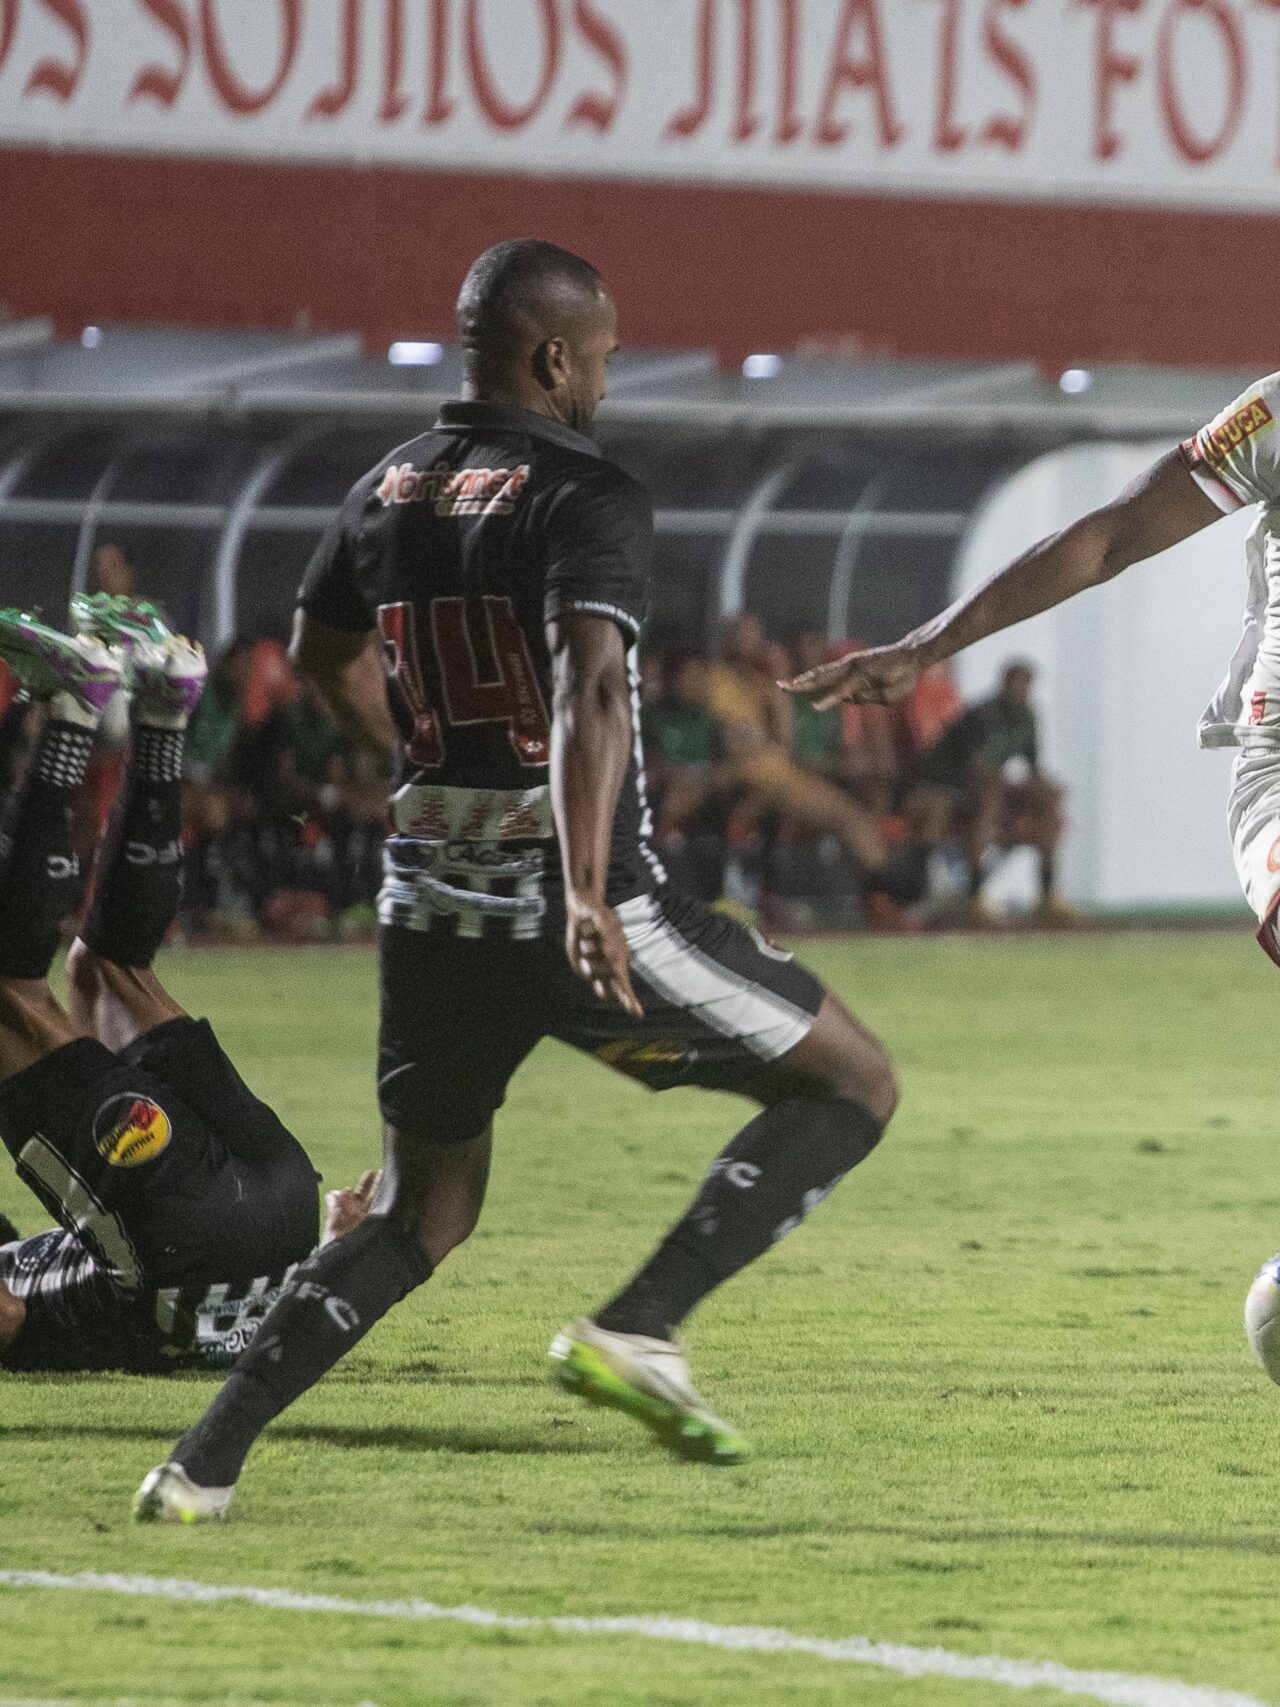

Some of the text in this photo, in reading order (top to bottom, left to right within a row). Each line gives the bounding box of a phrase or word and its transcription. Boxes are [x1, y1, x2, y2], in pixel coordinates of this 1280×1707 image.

[0, 0, 92, 106] S
[124, 0, 629, 137] SOMOS
[660, 0, 1037, 154] MAIS
[376, 596, 549, 768] 14
